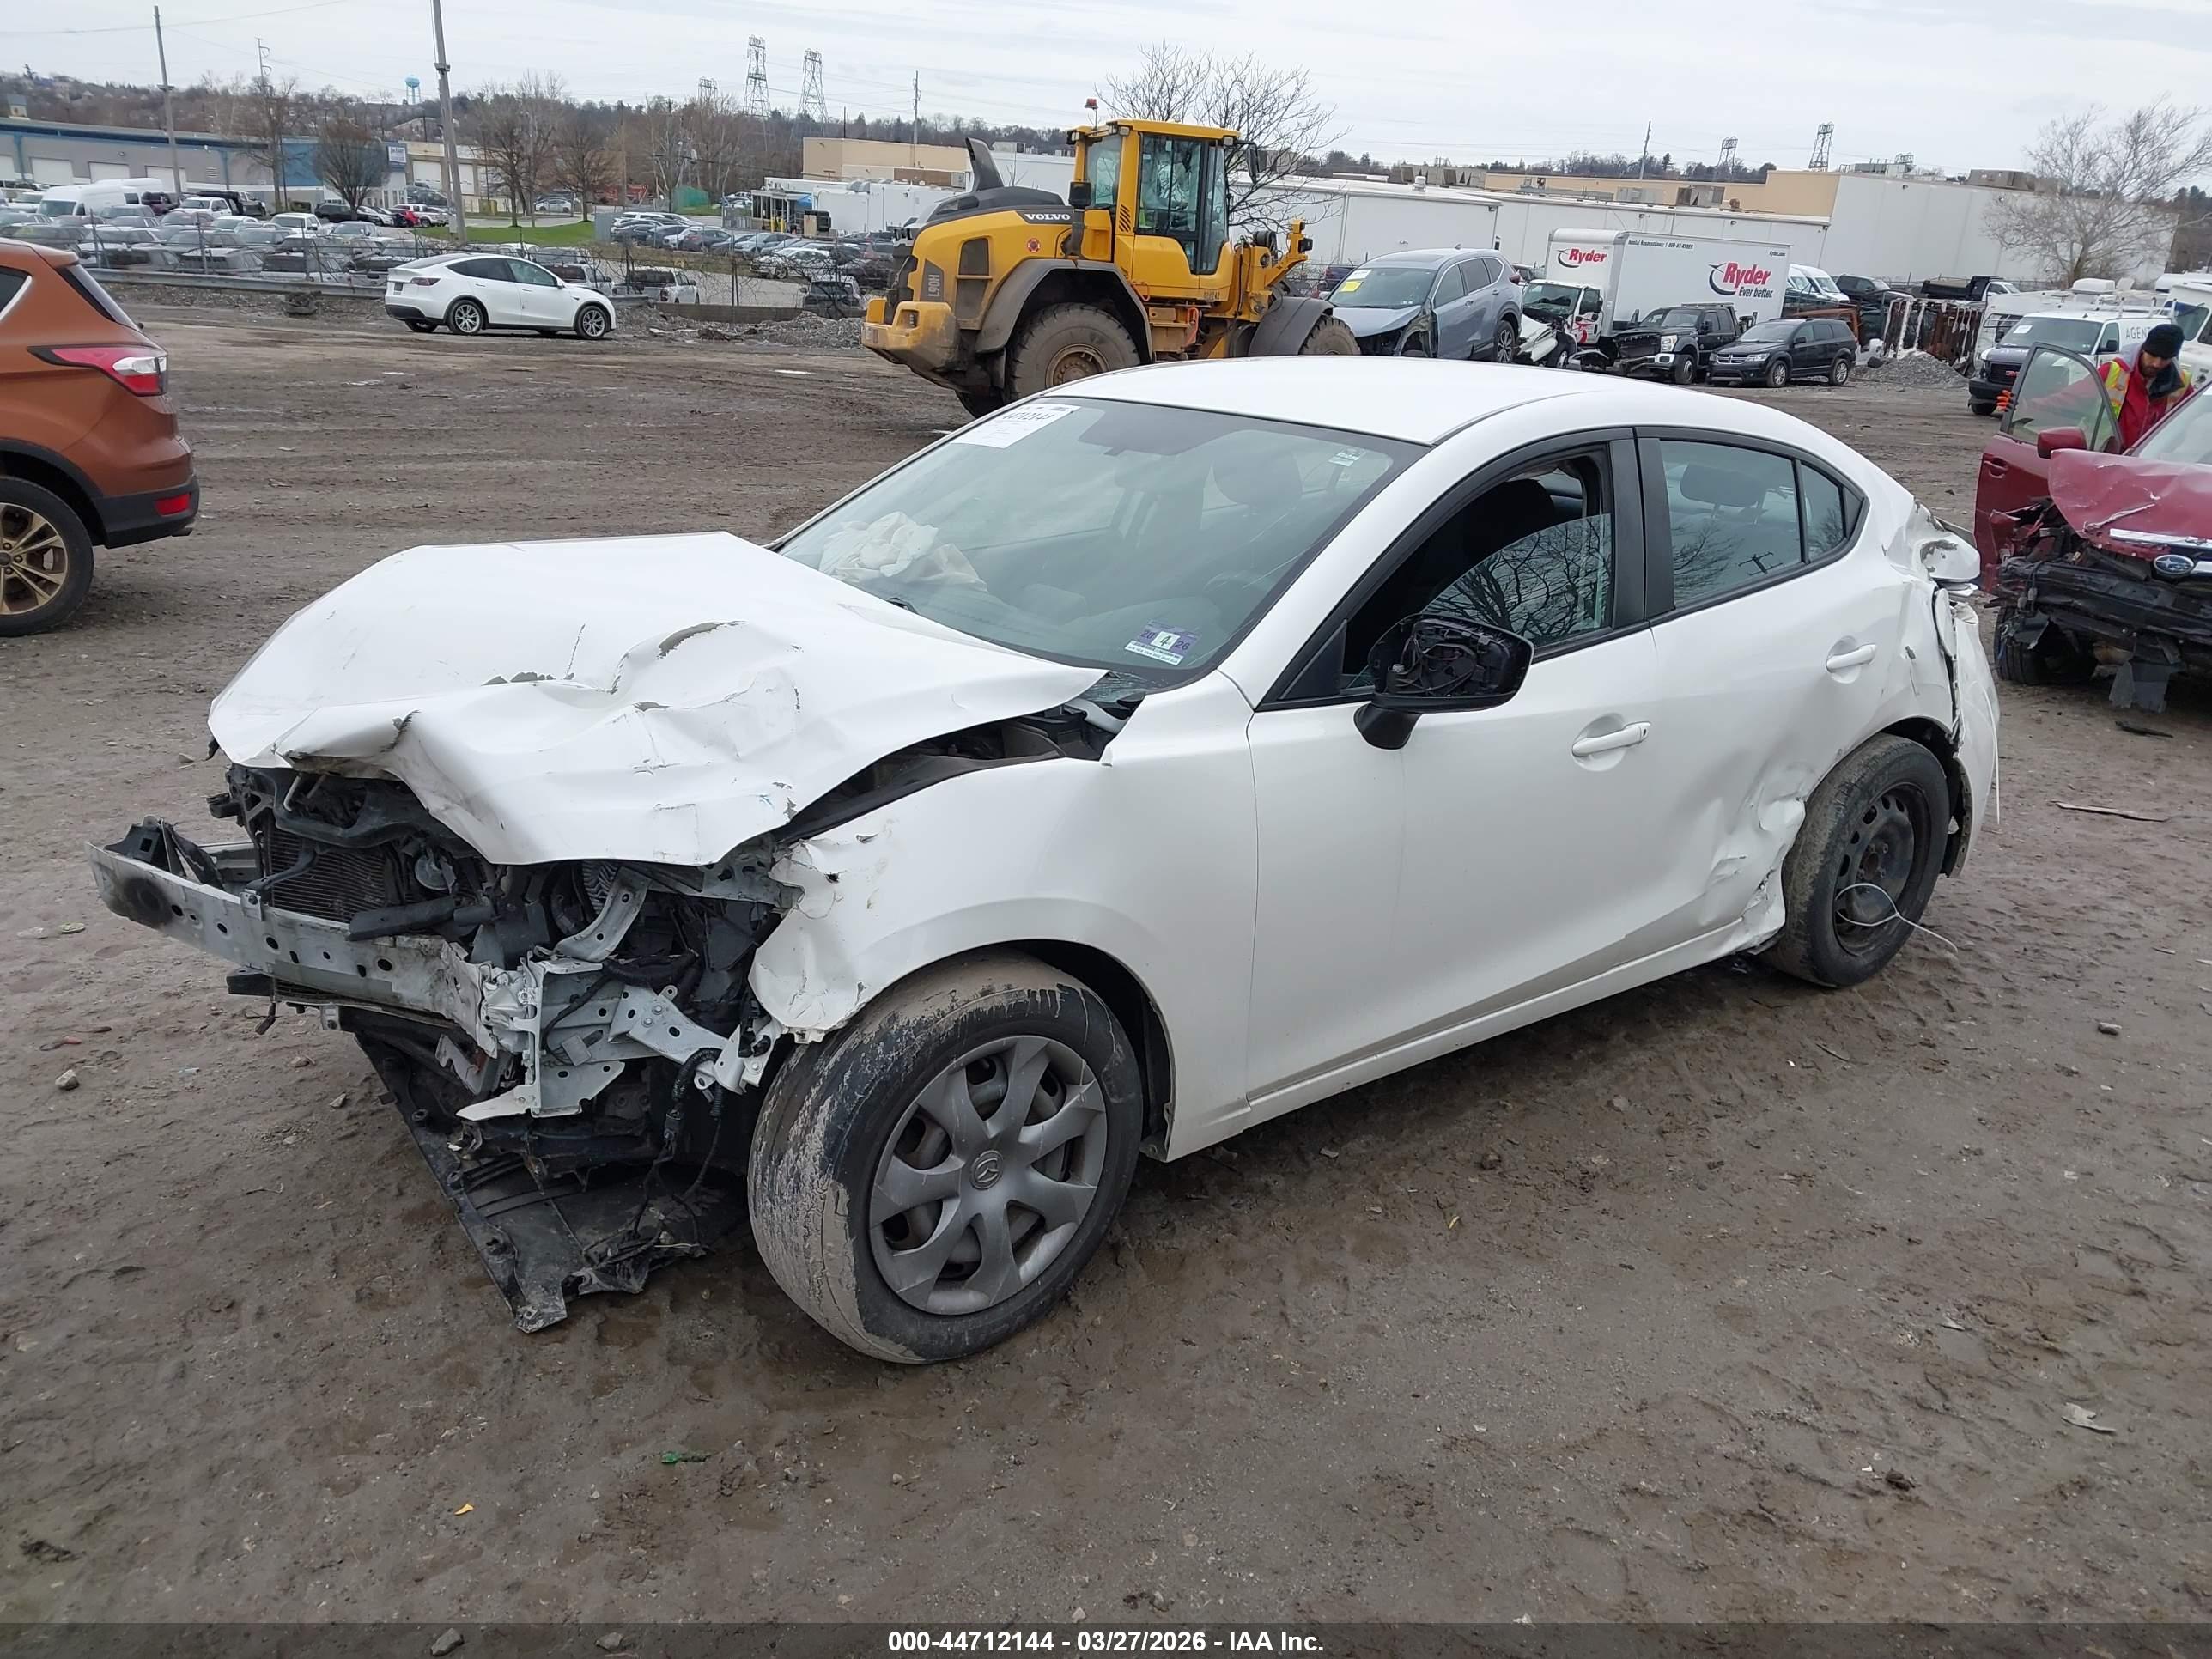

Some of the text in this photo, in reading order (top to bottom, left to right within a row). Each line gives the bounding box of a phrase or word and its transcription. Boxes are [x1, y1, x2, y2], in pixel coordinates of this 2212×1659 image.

[1568, 248, 1608, 264] Ryder
[1723, 262, 1772, 289] Ryder
[927, 274, 940, 297] L90H
[1739, 287, 1753, 297] Ever
[1159, 635, 1172, 647] 4
[1175, 641, 1190, 651] 26
